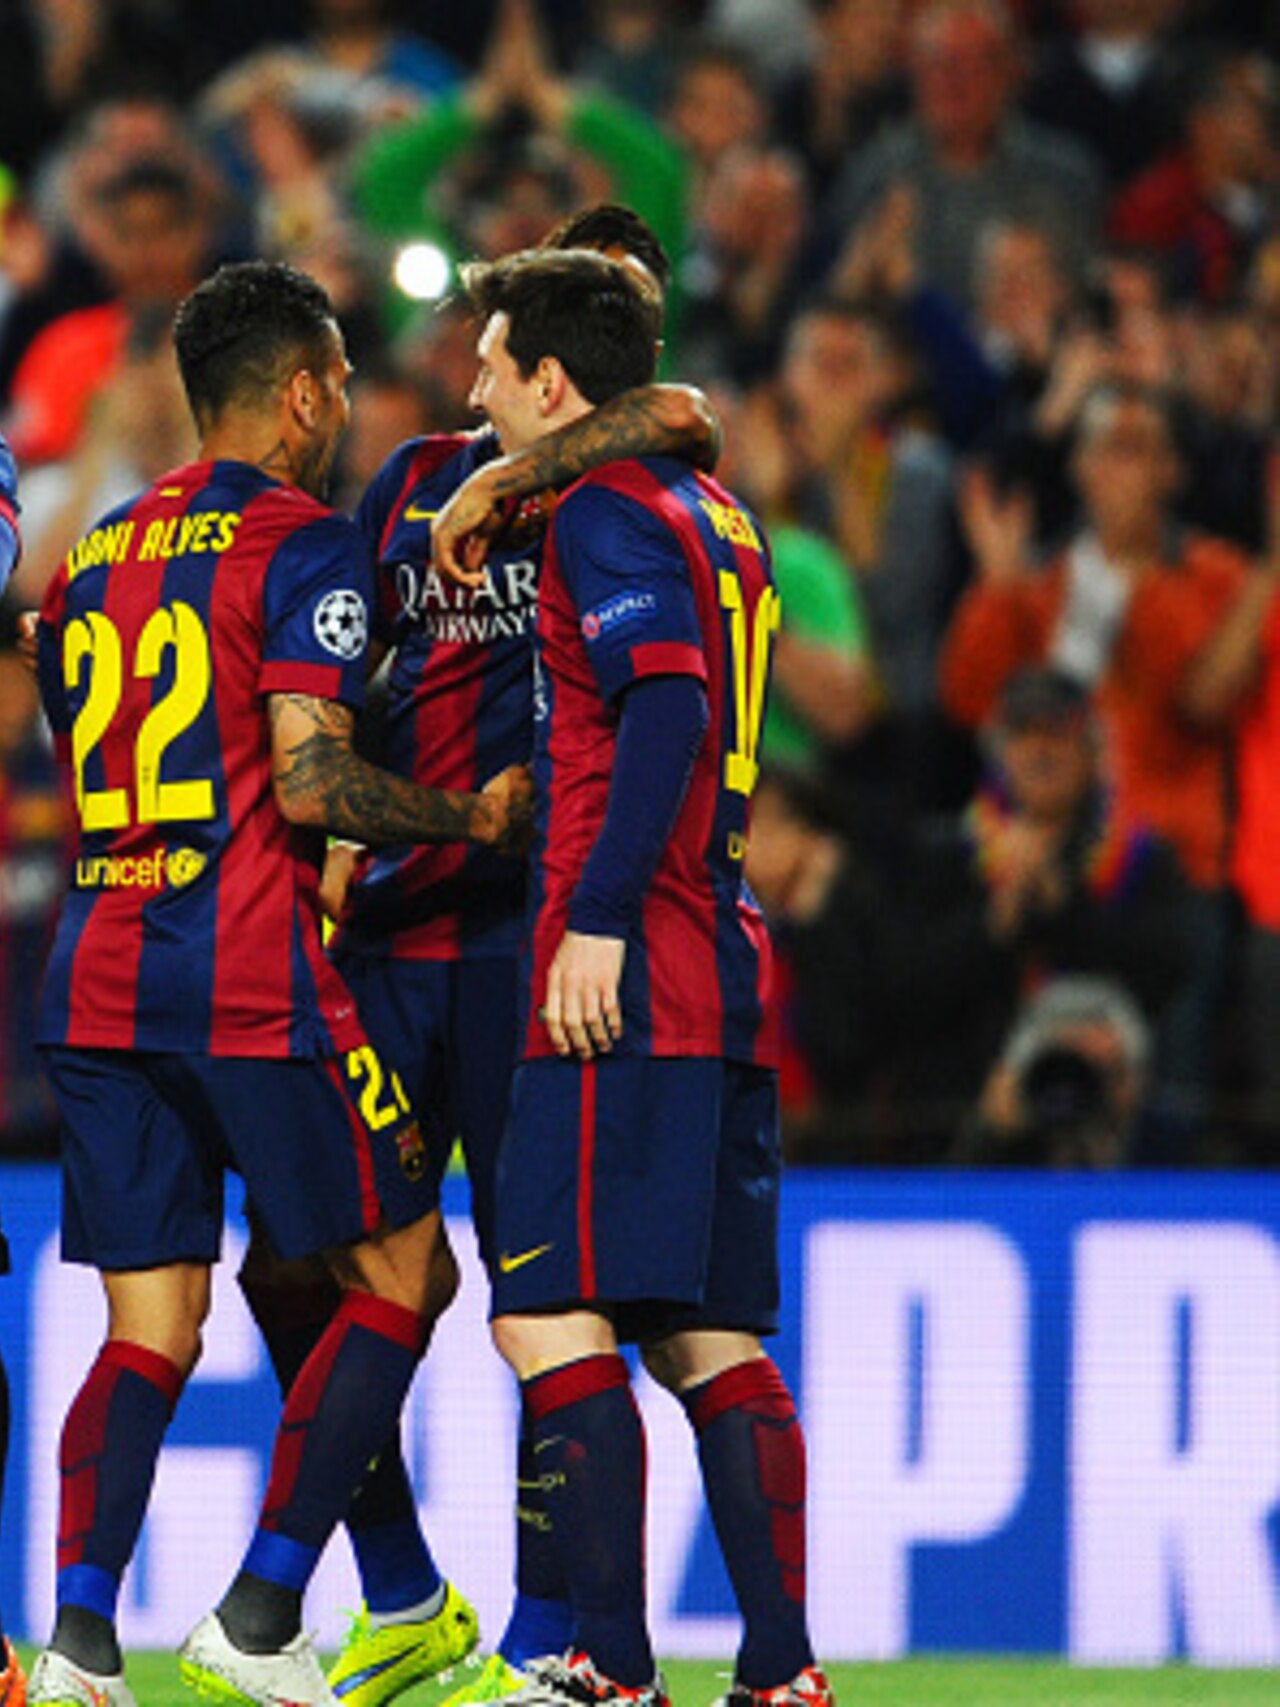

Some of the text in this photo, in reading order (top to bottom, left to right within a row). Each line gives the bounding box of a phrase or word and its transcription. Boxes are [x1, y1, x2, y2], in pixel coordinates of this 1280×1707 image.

[138, 511, 241, 561] ALVES
[63, 599, 216, 832] 22
[76, 842, 168, 888] unicef
